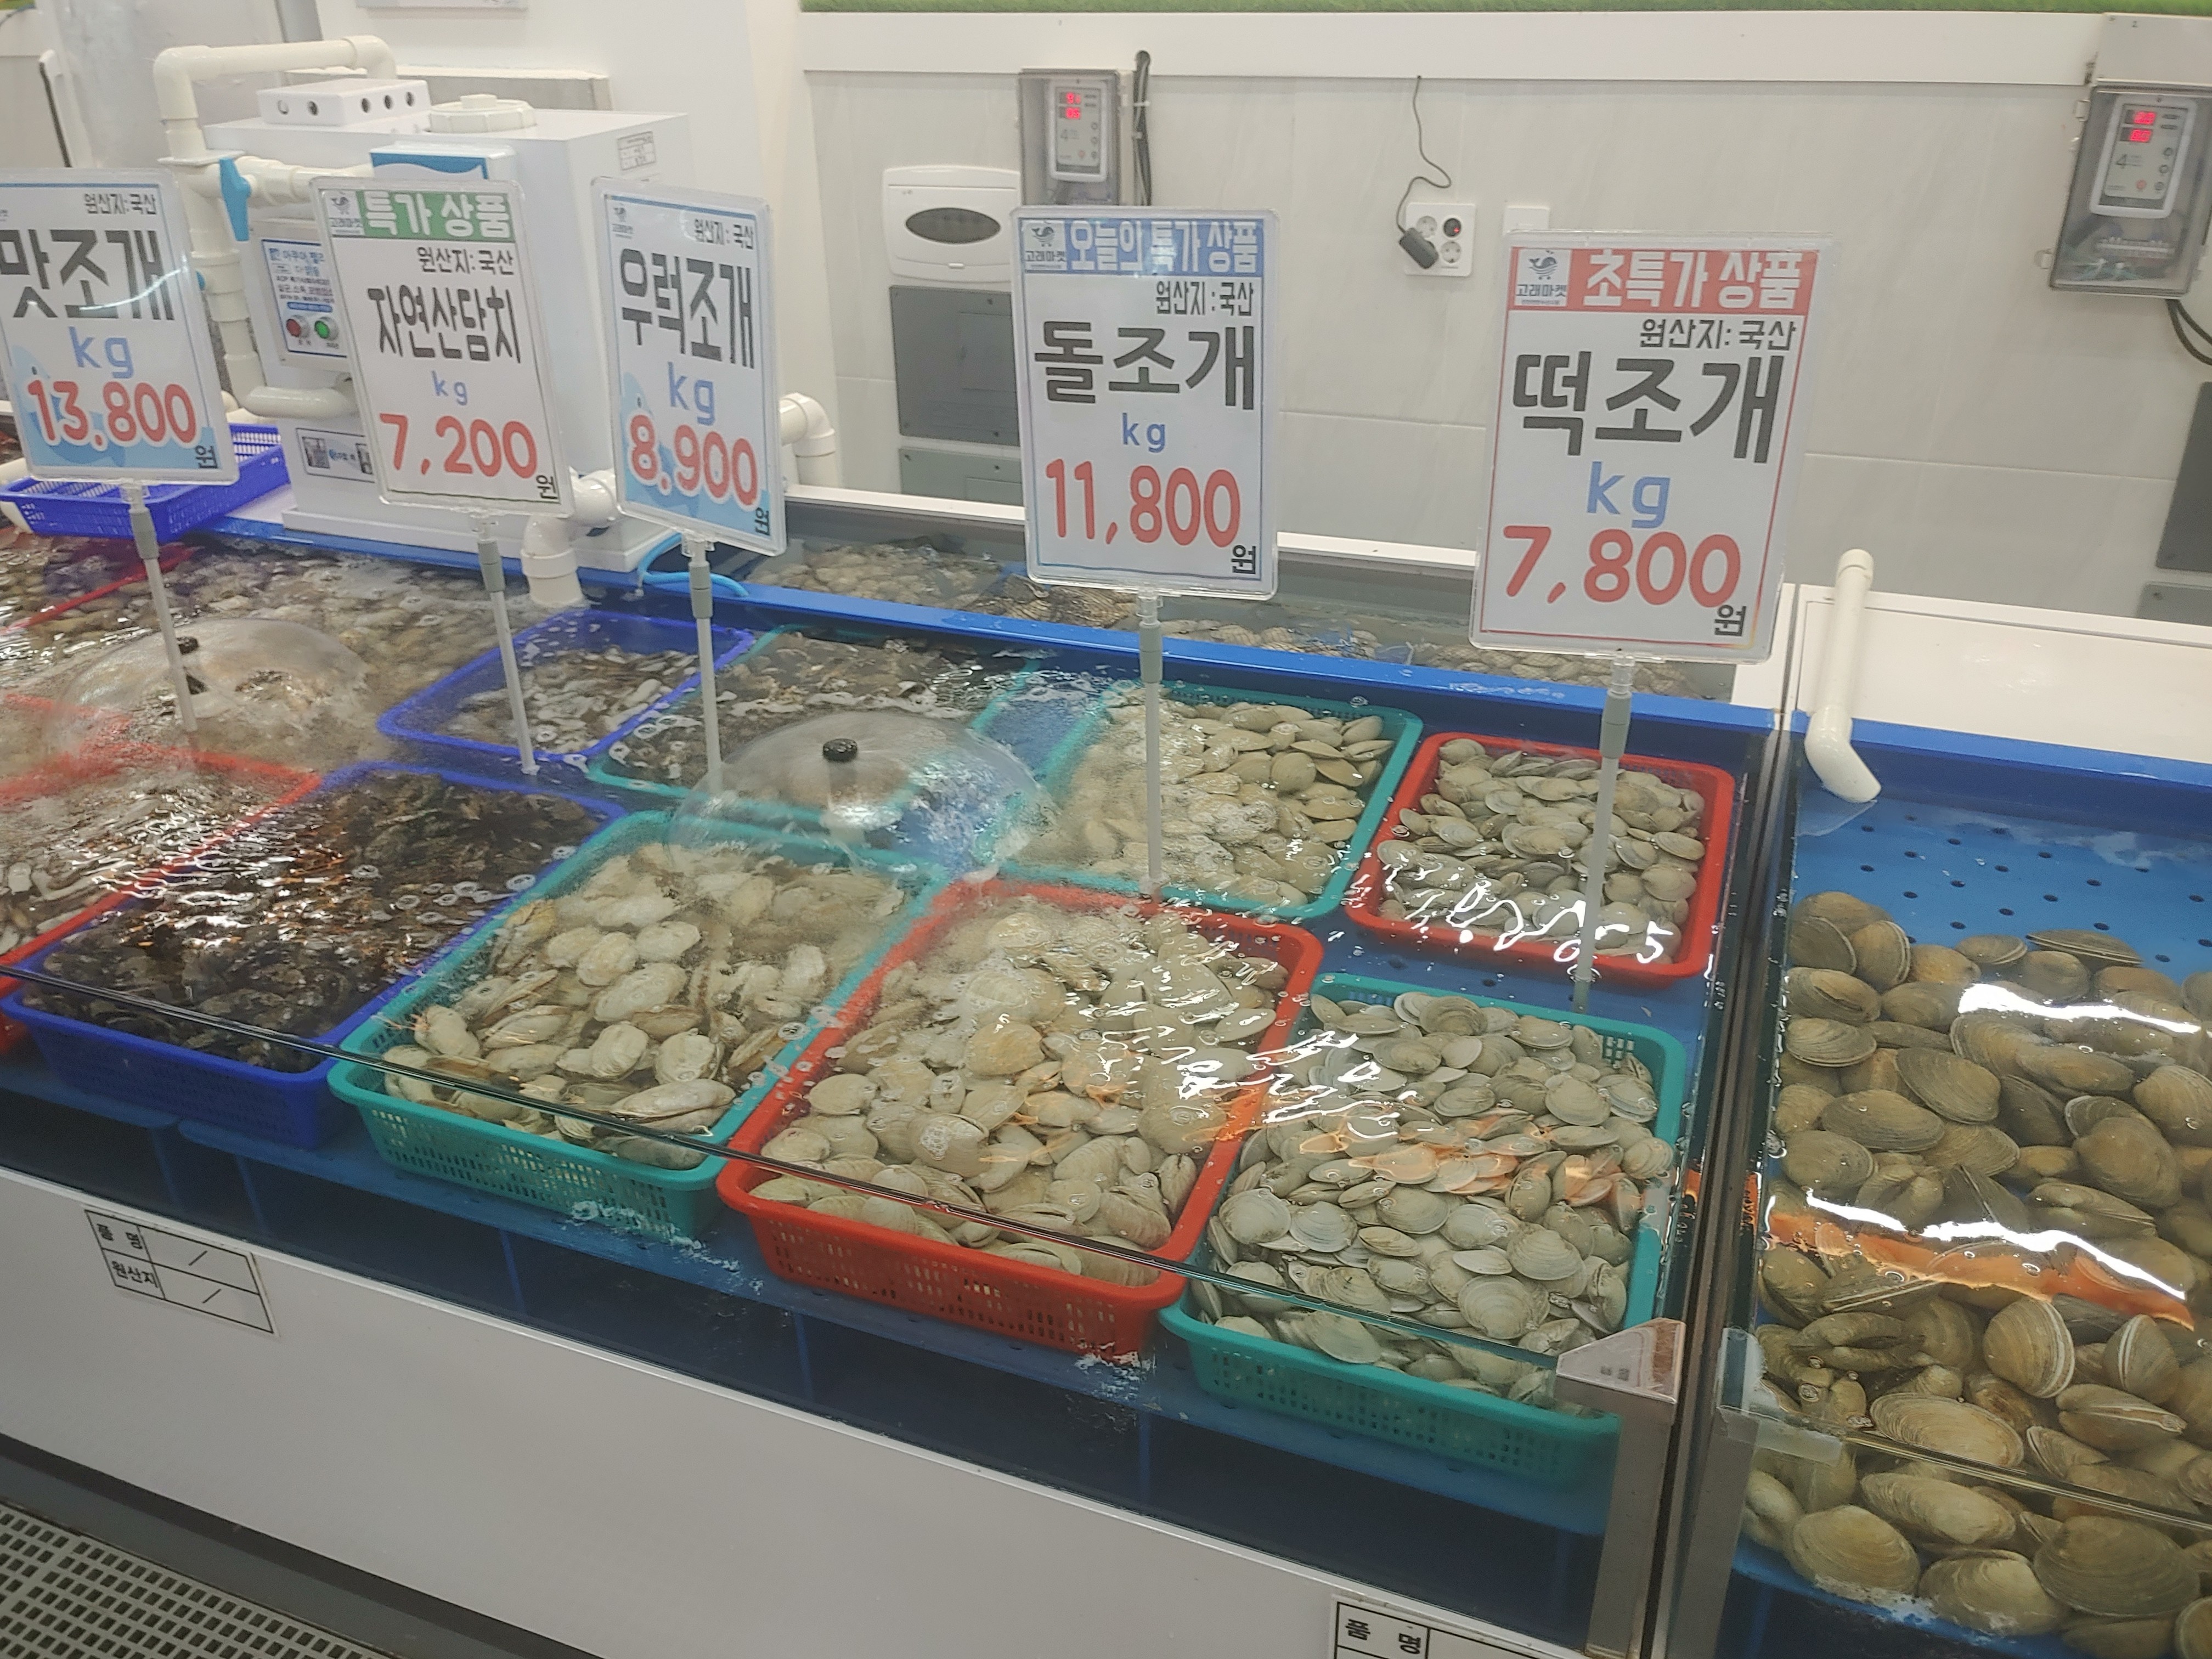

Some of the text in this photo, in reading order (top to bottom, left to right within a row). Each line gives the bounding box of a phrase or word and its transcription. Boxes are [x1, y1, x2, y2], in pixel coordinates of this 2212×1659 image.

[363, 191, 511, 238] 특가 상품
[0, 229, 174, 320] 맛조개
[1069, 221, 1258, 273] 오늘의 특가 상품
[620, 248, 754, 369] 우럭조개
[1516, 284, 1566, 297] 고래마켓
[1583, 249, 1803, 309] 초특가 상품
[69, 326, 133, 379] kg
[368, 284, 521, 363] 자연산담치
[432, 370, 469, 405] kg
[668, 362, 715, 425] kg
[1034, 320, 1254, 410] 돌조개
[1122, 413, 1165, 453] kg
[1513, 351, 1784, 464] 떡조개
[195, 445, 218, 469] 원
[379, 413, 558, 500] 7,200 원
[754, 507, 771, 536] 원
[1046, 459, 1256, 574] 11,800 원
[1586, 461, 1671, 529] kg
[1503, 525, 1747, 637] 7,800 원
[112, 1260, 158, 1288] 원산지
